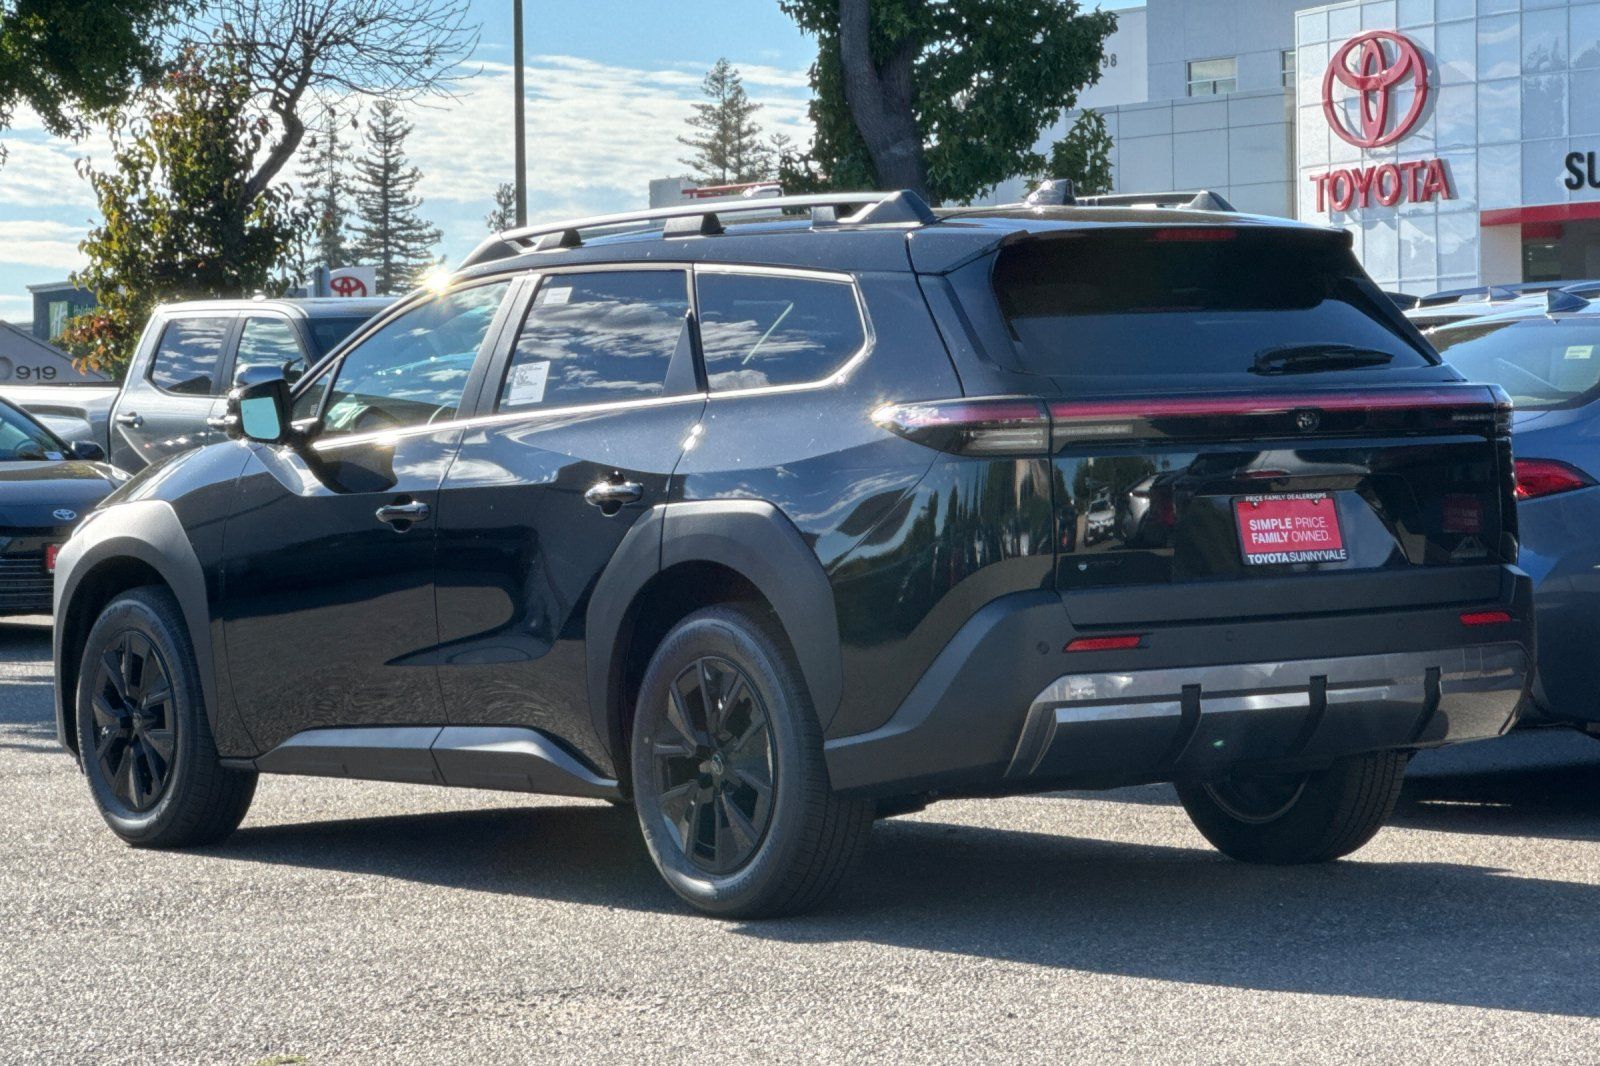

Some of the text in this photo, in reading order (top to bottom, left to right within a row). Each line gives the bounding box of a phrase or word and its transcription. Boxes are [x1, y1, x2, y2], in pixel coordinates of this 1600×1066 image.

[1310, 158, 1450, 212] TOYOTA
[15, 365, 57, 380] 919
[1286, 492, 1327, 500] DEALERSHIPS
[1249, 516, 1328, 531] SIMPLE PRICE.
[1251, 529, 1331, 544] FAMILY OWNED.
[1248, 550, 1347, 564] TOYOTA SUNNYVALE
